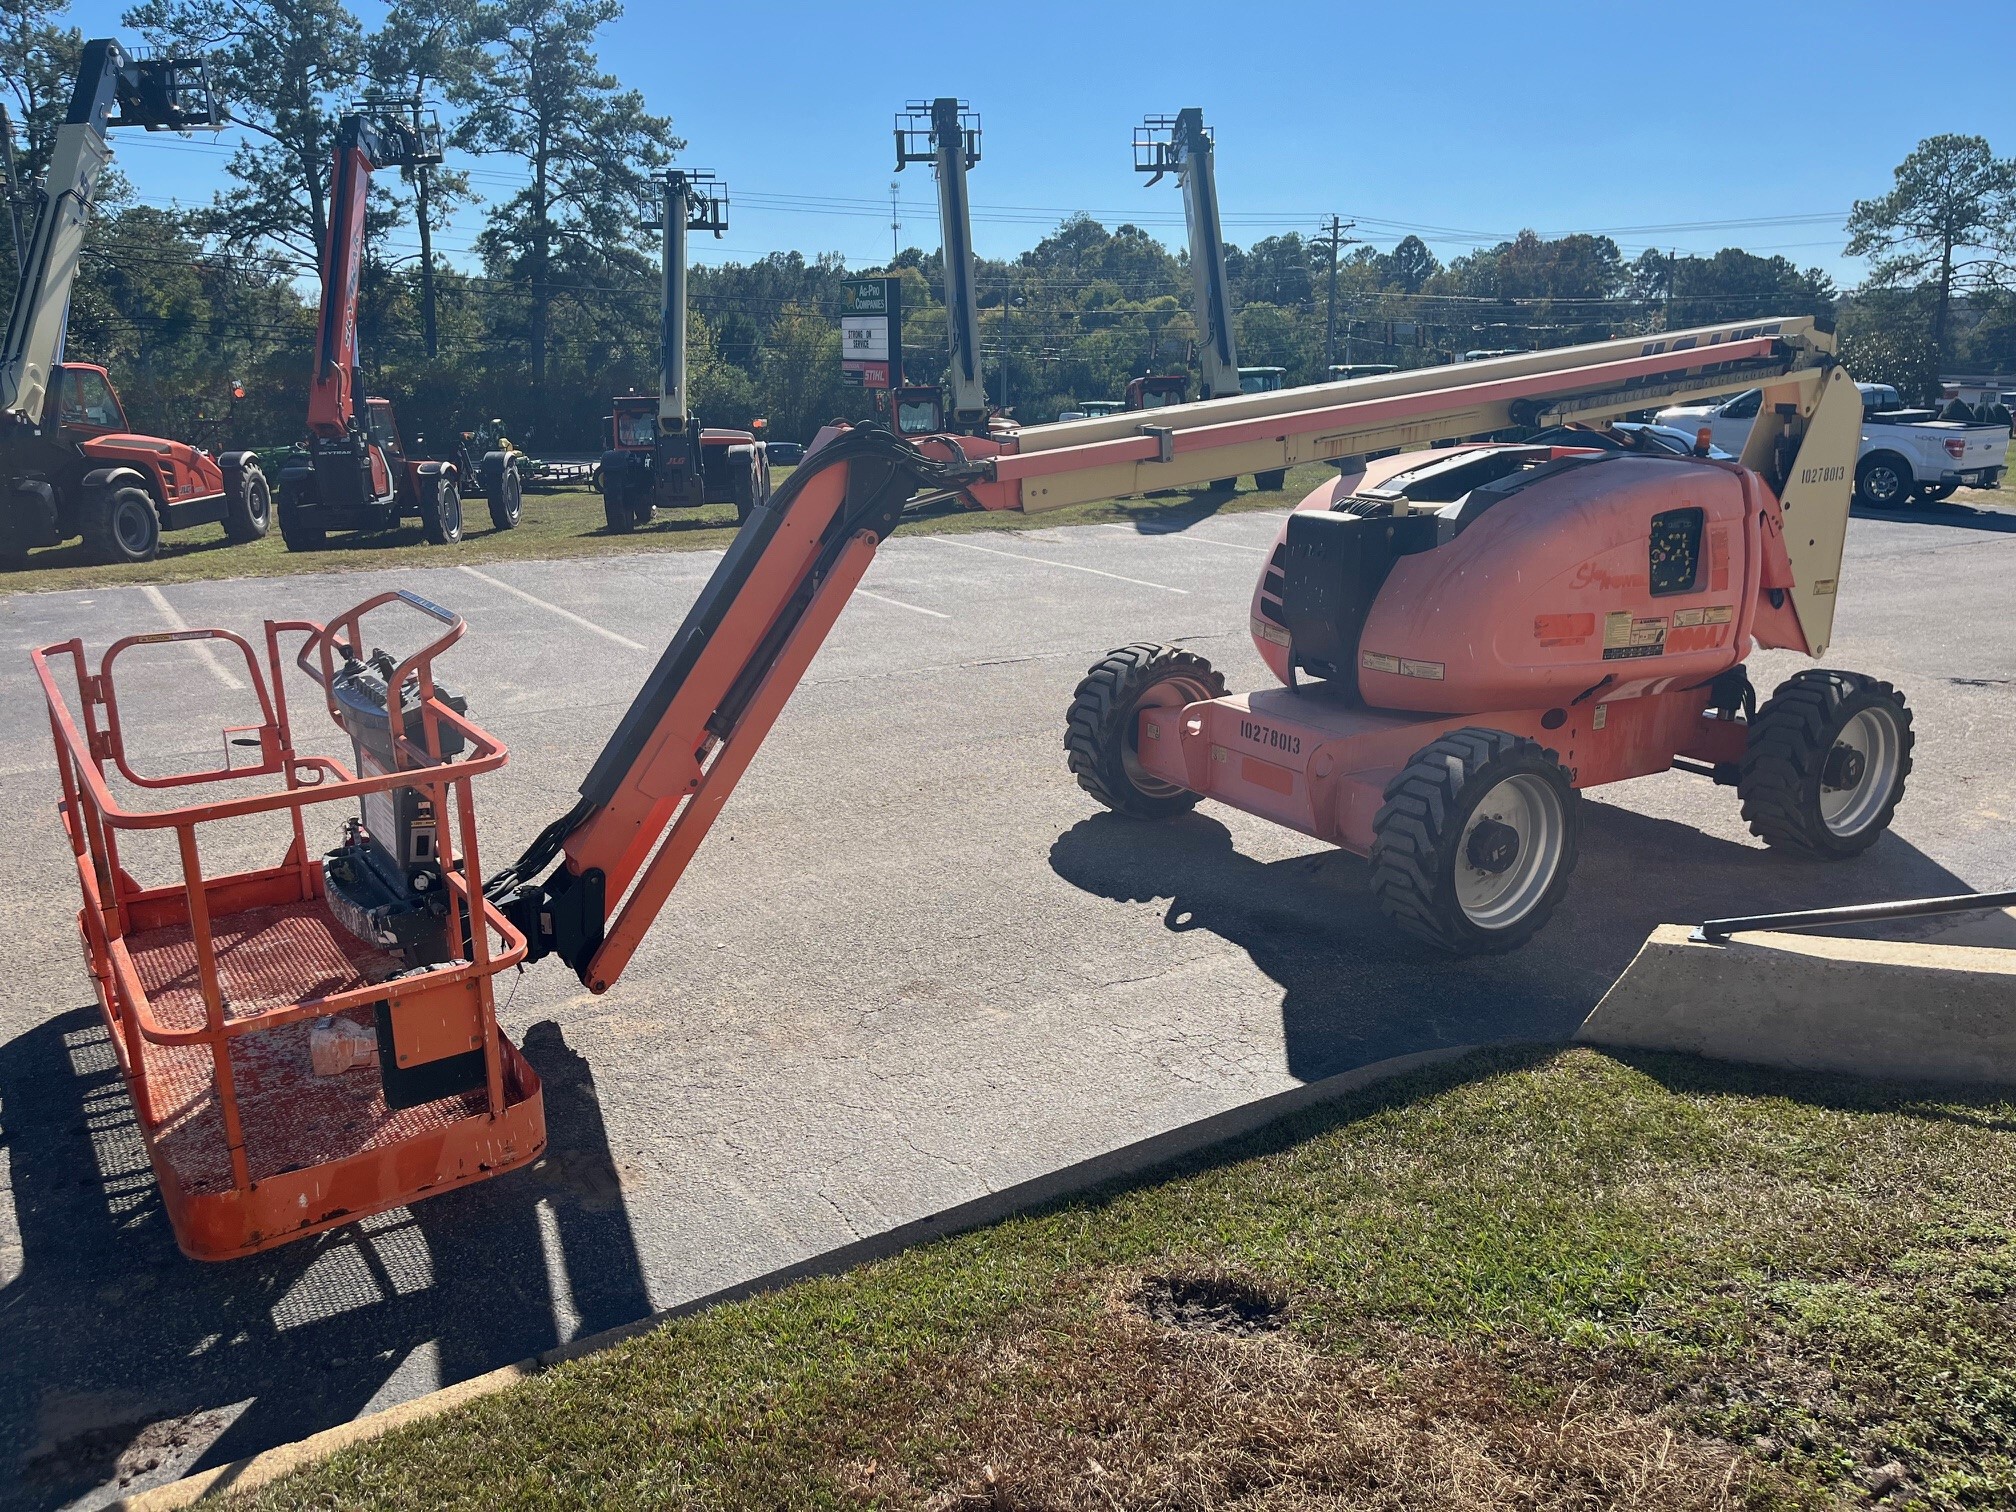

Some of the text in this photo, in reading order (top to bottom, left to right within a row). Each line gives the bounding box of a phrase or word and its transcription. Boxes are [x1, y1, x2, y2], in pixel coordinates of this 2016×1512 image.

[848, 330, 872, 339] STRONG ON
[853, 339, 869, 349] SERVICE
[865, 370, 884, 380] STIHL
[1801, 466, 1845, 484] 10278013
[1239, 719, 1301, 755] 10278013
